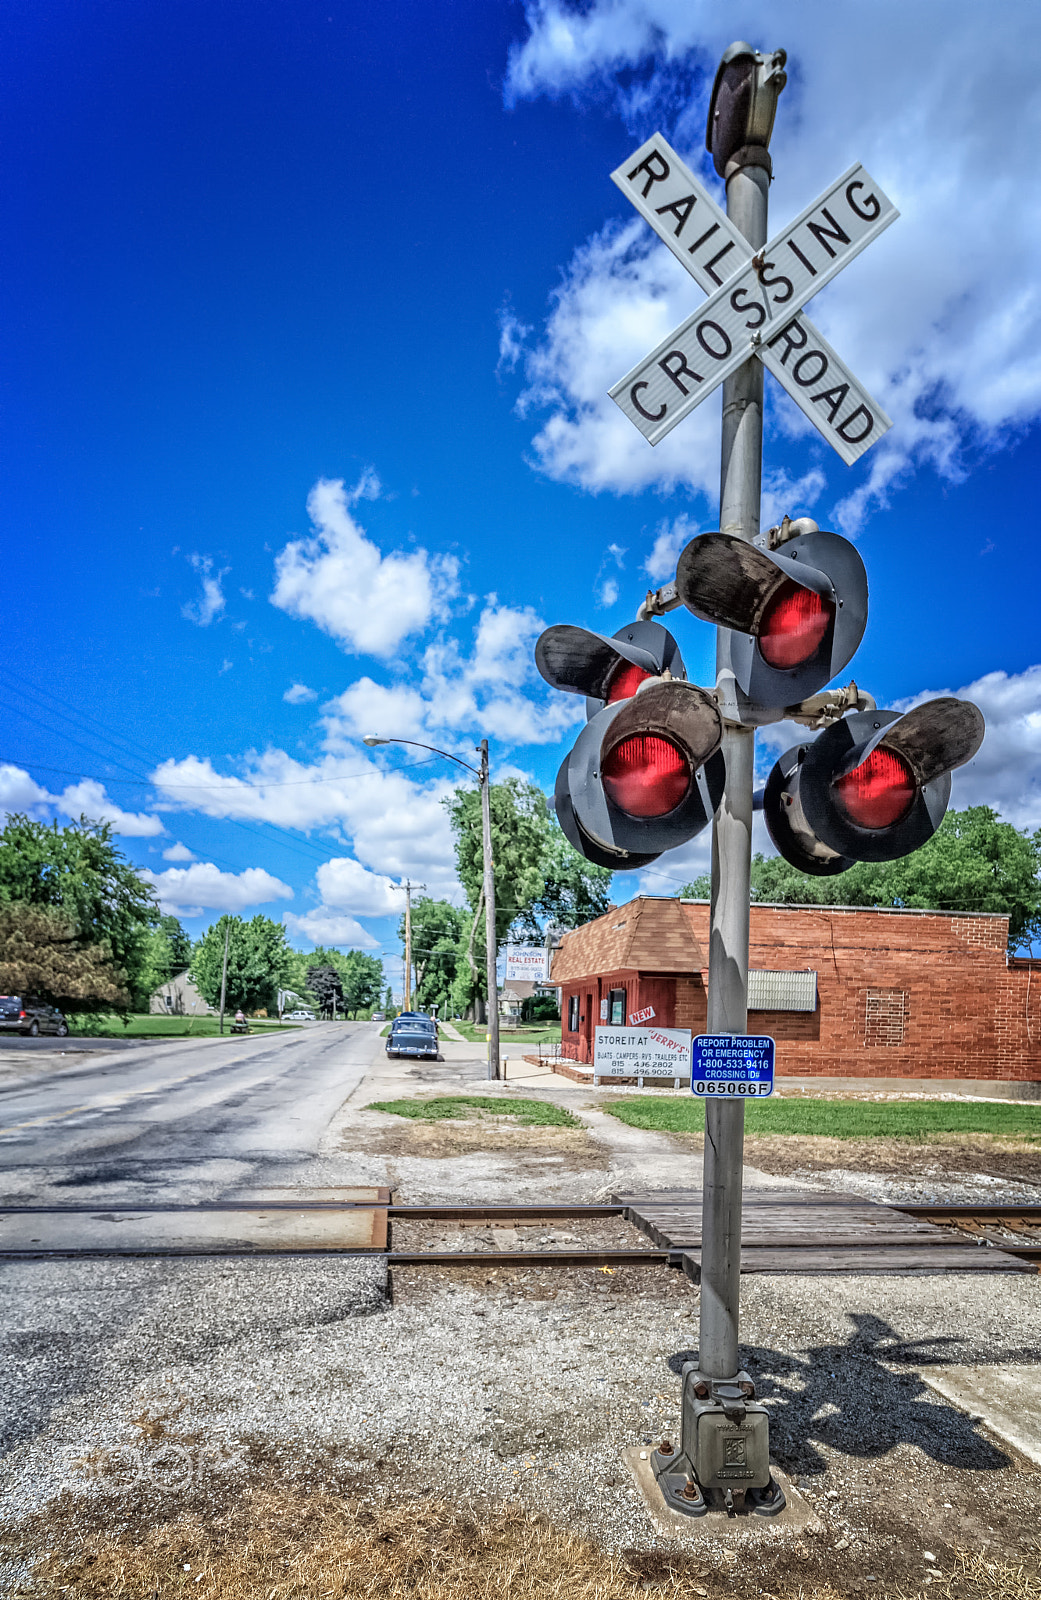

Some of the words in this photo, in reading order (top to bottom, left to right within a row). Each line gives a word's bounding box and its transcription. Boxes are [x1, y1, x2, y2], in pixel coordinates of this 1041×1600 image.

[627, 149, 735, 287] RAIL
[767, 318, 875, 444] ROAD
[630, 180, 881, 422] CROSSING
[632, 1007, 652, 1023] NEW
[598, 1036, 627, 1045] STORE
[628, 1036, 636, 1045] IT
[637, 1037, 648, 1045] AT
[697, 1039, 730, 1047] REPORT
[731, 1039, 770, 1048] PROBLEM
[616, 1052, 638, 1060] CAMPERS
[654, 1053, 677, 1061] TRAILERS
[701, 1049, 714, 1057] OR
[715, 1049, 765, 1058] EMERGENCY
[697, 1059, 769, 1069] 1-800-533-9416
[705, 1070, 746, 1078] CROSSING
[747, 1070, 761, 1079] ID#
[696, 1081, 768, 1095] 065066F
